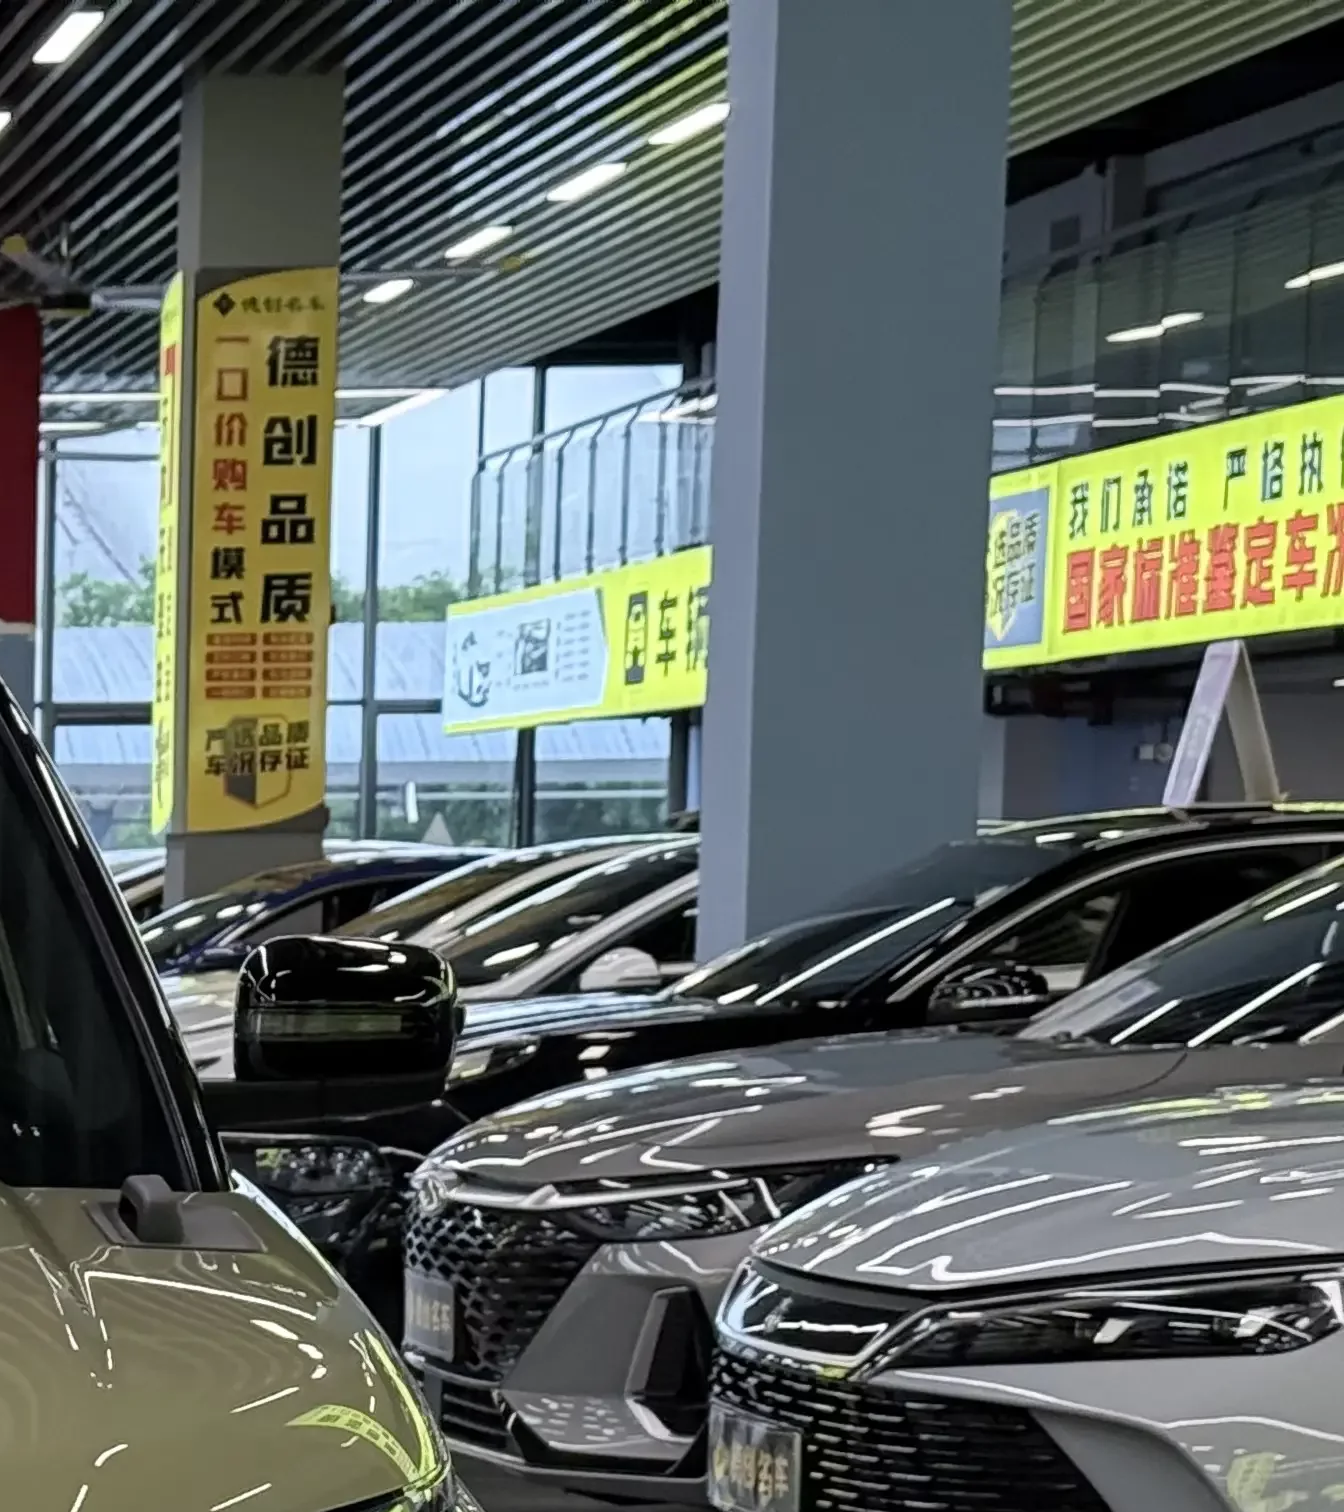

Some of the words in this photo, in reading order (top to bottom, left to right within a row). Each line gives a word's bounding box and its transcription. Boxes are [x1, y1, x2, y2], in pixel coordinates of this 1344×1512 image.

[210, 335, 250, 625] 一口价购车模式
[260, 335, 320, 624] 德创品质
[1068, 460, 1189, 541] 我们承诺
[1222, 431, 1344, 511] 严格执
